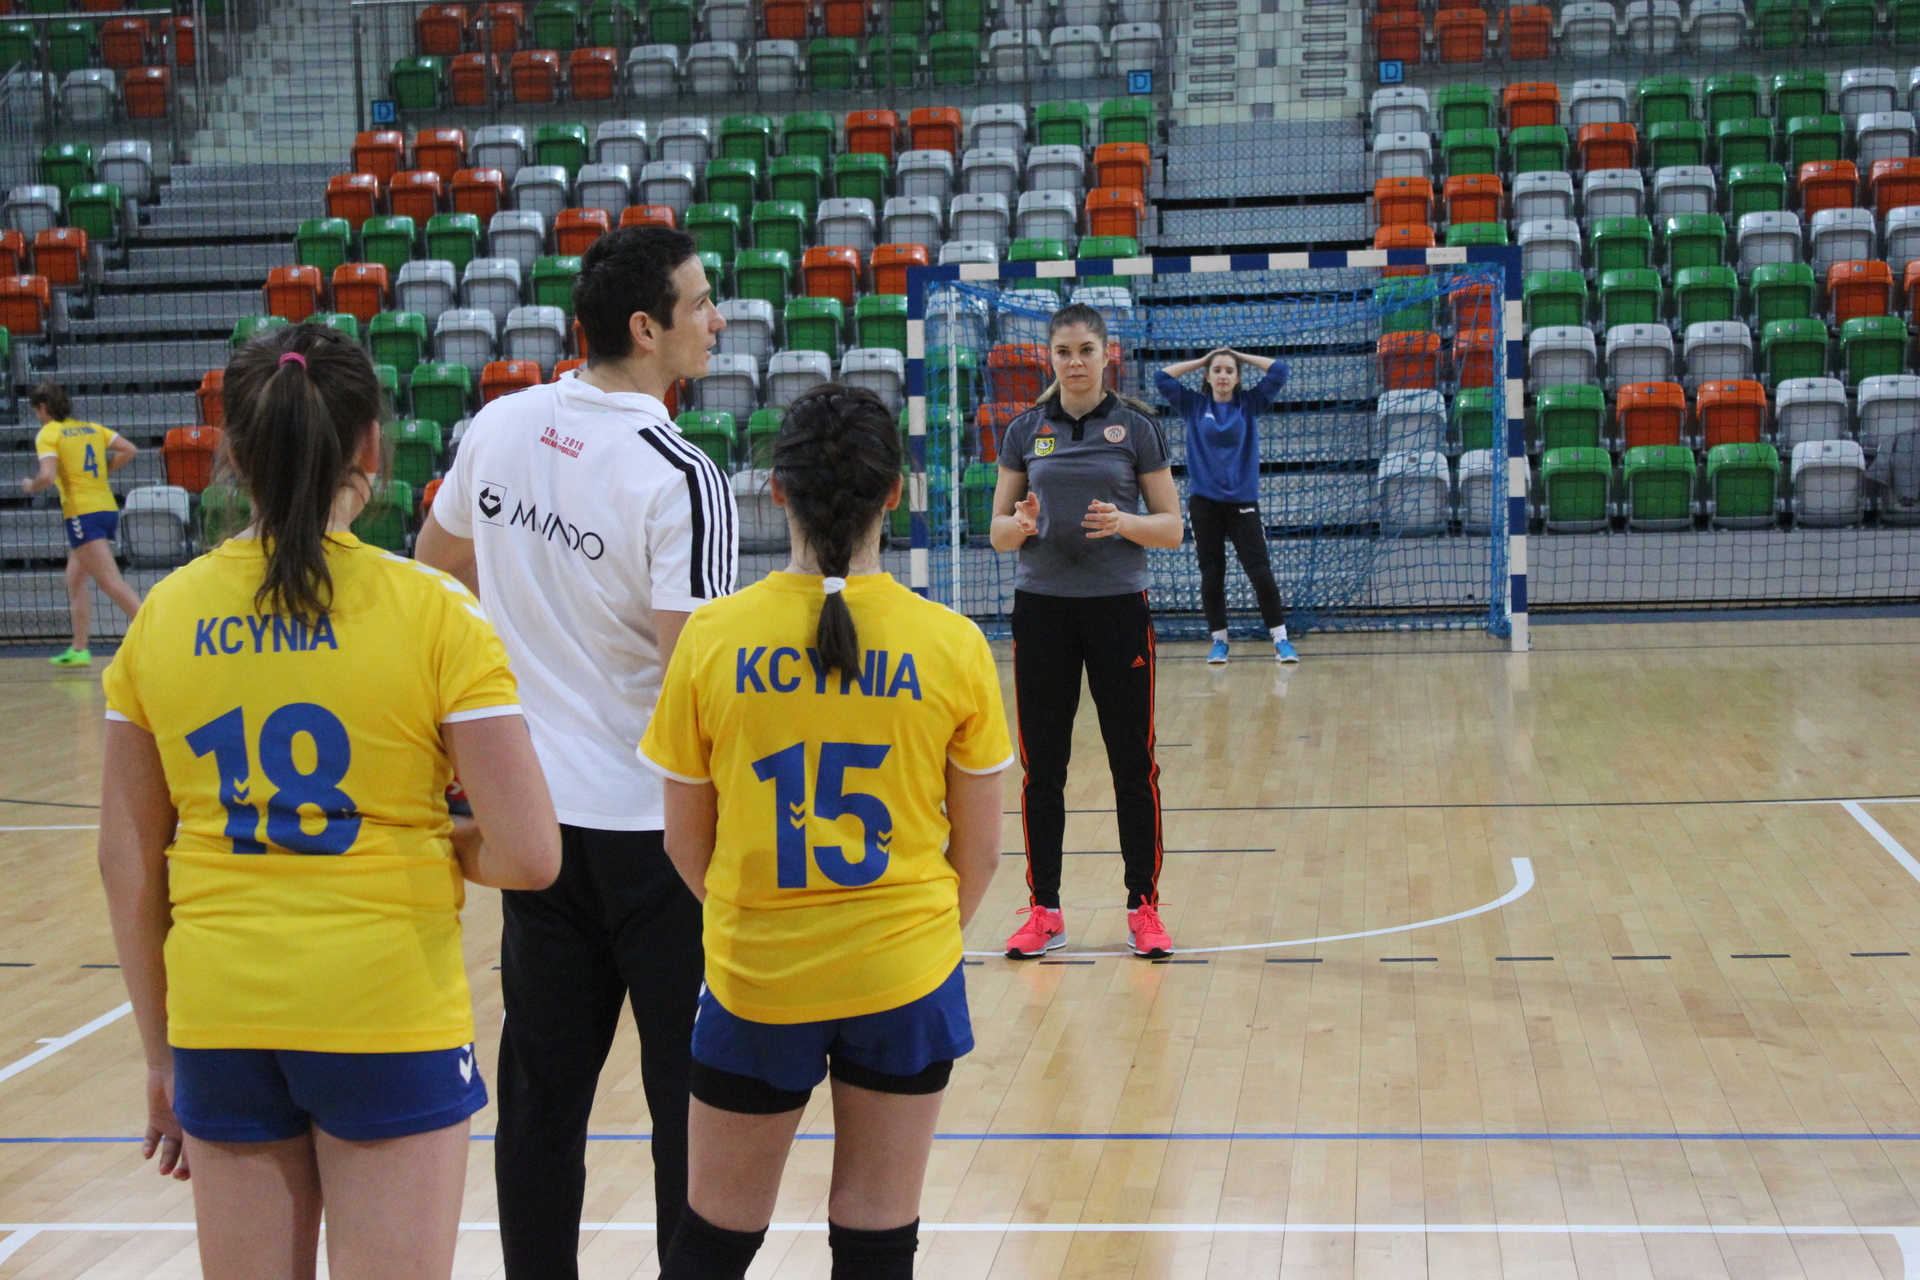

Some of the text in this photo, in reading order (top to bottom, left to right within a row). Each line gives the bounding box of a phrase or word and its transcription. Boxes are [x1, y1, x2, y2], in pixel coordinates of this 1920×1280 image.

[1134, 74, 1147, 90] D
[1385, 63, 1398, 80] D
[378, 104, 391, 120] D
[562, 436, 584, 450] 2018
[83, 444, 98, 478] 4
[194, 612, 338, 656] KCYNIA
[736, 646, 922, 700] KCYNIA
[185, 702, 363, 855] 18
[751, 741, 893, 888] 15
